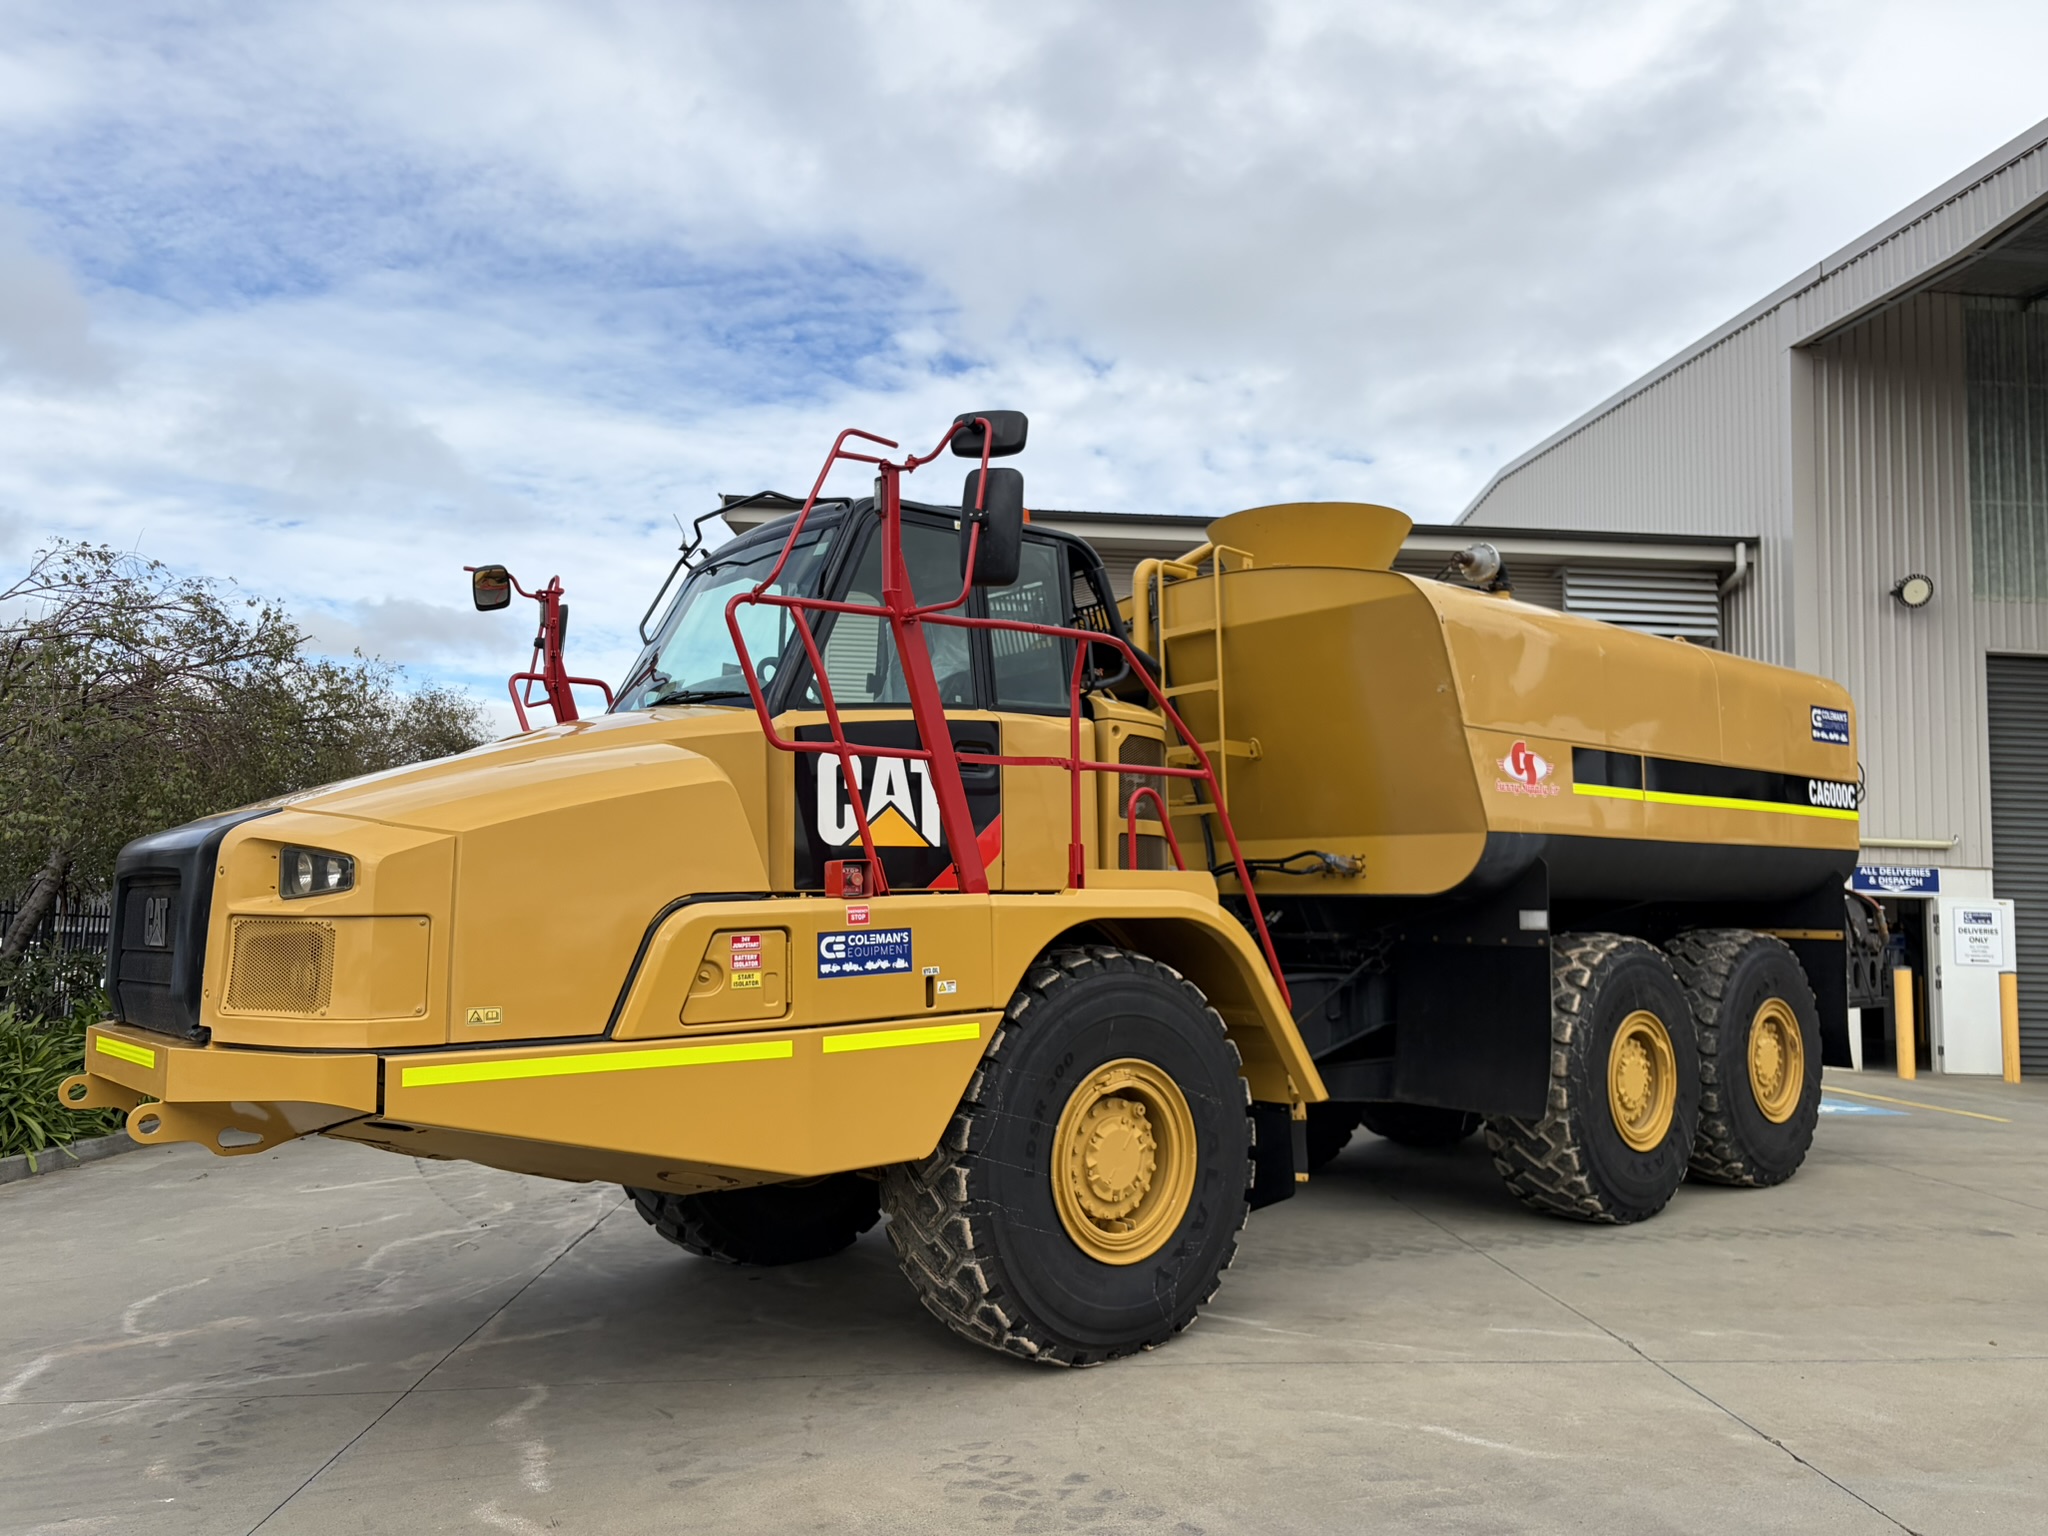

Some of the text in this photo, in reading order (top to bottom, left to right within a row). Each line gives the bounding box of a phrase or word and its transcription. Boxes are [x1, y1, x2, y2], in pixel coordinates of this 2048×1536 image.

[817, 752, 941, 847] CAT
[1808, 779, 1857, 810] CA6000C
[1860, 866, 1931, 877] ALL DELIVERIES
[1868, 876, 1923, 887] & DISPATCH
[144, 897, 169, 947] CAT
[851, 913, 866, 921] STOP
[1958, 927, 1999, 936] DELIVERIES
[848, 931, 909, 946] COLEMAN'S
[1969, 936, 1989, 945] ONLY
[847, 944, 909, 958] EQUIPMENT
[733, 960, 758, 968] ISOLATOR
